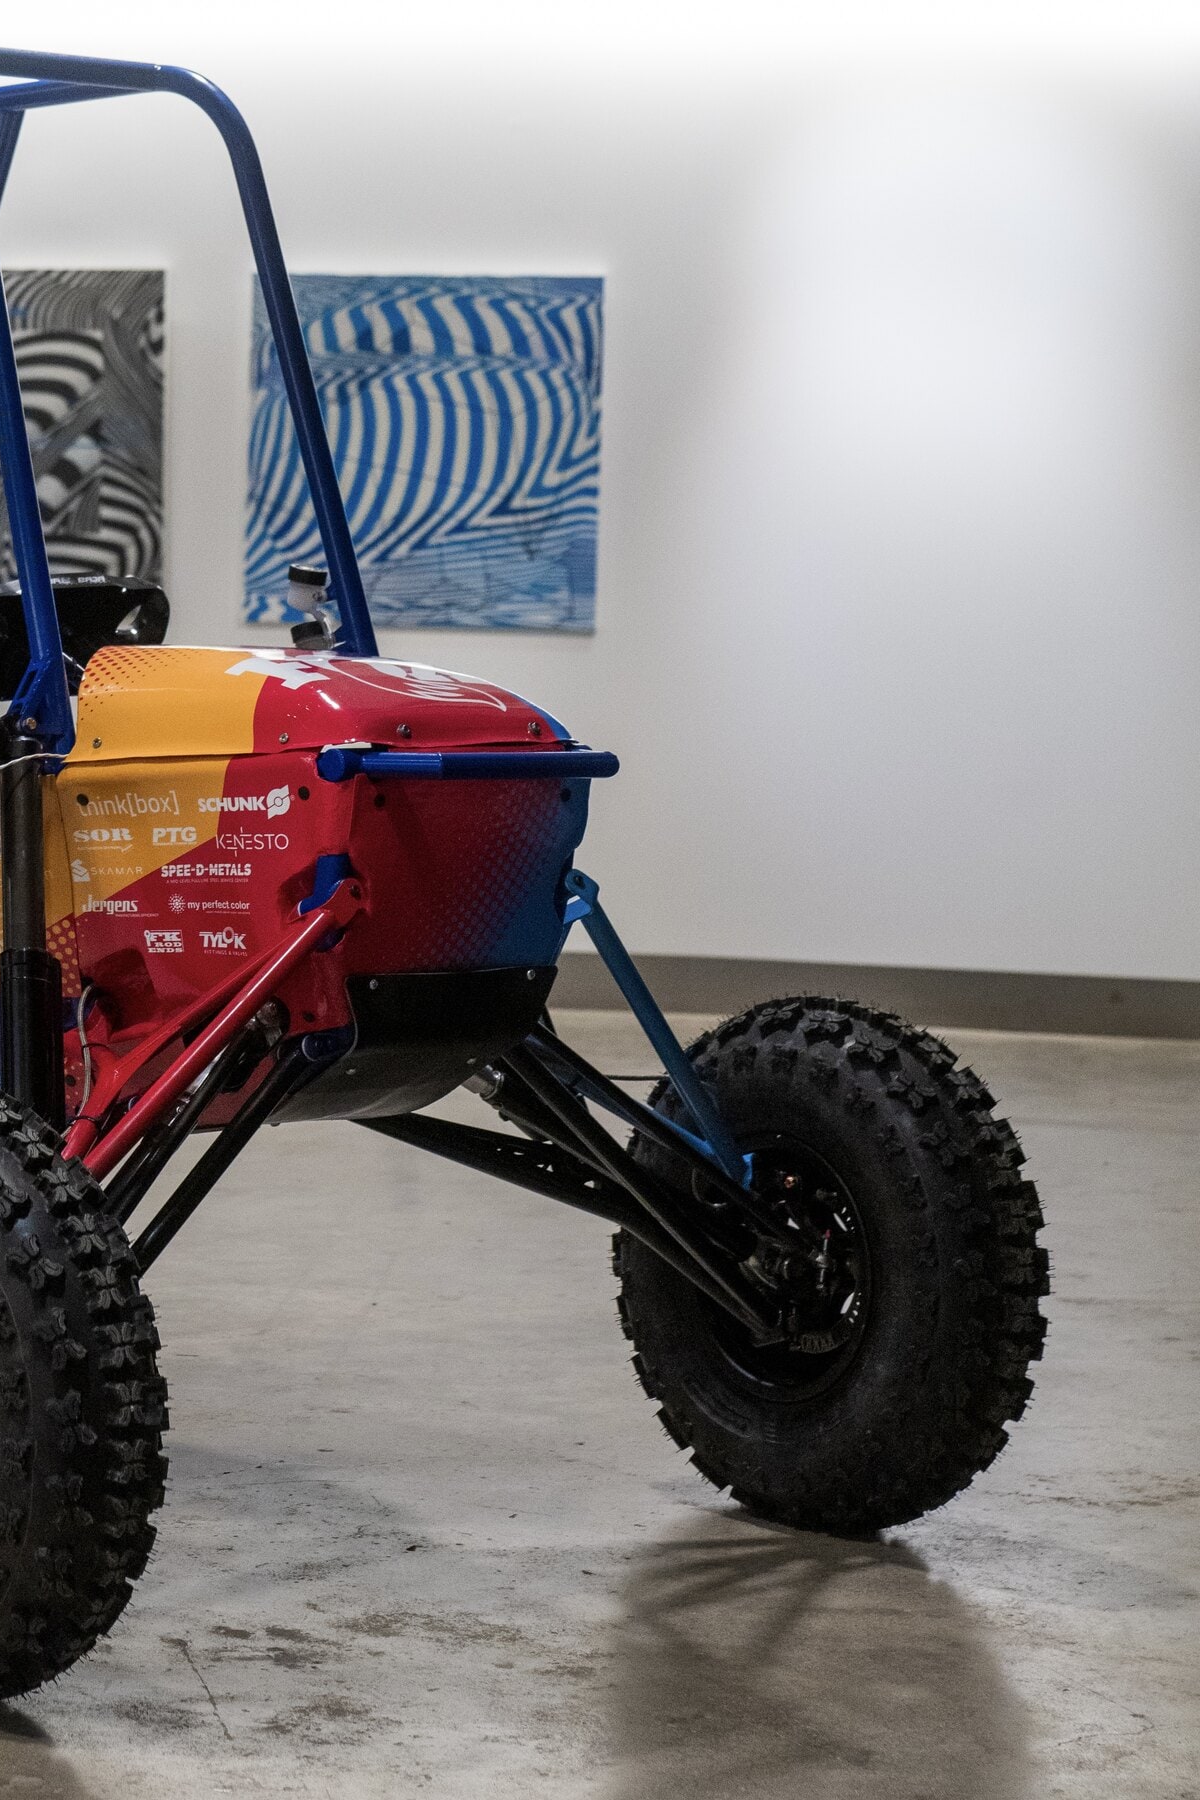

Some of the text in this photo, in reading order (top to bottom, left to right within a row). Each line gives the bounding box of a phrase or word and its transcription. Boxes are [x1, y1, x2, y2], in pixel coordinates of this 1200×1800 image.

[197, 795, 267, 813] SCHUNK
[73, 827, 135, 843] SOR
[152, 826, 198, 843] PTG
[90, 866, 144, 875] SKAMAR
[160, 863, 252, 878] SPEE-D-METALS
[81, 894, 139, 916] Jergens
[187, 899, 251, 911] my perfect color
[198, 926, 247, 950] TYLOK
